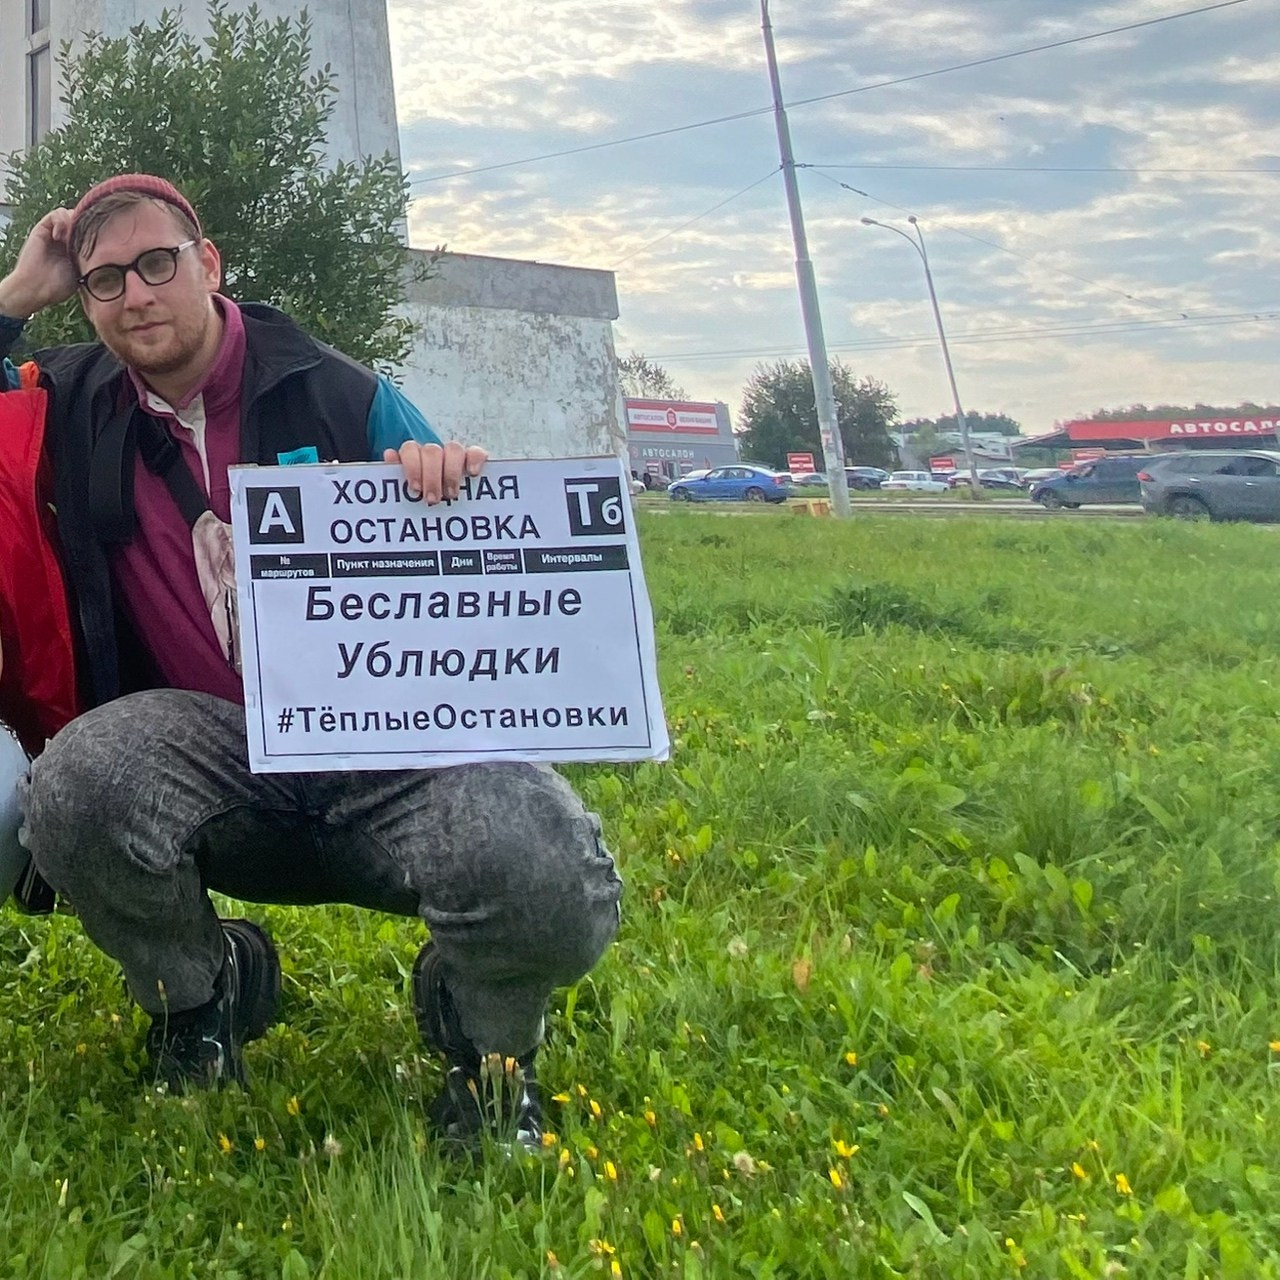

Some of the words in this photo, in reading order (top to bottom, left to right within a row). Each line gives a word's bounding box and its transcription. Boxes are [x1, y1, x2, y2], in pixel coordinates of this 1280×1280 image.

[642, 448, 695, 458] АВТОСАЛОН
[332, 475, 520, 507] ХОЛОНАЯ
[259, 491, 296, 535] А
[330, 514, 541, 544] ОСТАНОВКА
[280, 556, 291, 566] №
[336, 558, 370, 571] Пункт
[372, 557, 435, 569] назначения
[450, 556, 474, 569] Дни
[486, 552, 515, 563] Время
[541, 553, 603, 565] Интервалы
[260, 568, 315, 579] маршрутов
[485, 563, 518, 573] работы
[306, 586, 583, 621] Беславные
[336, 642, 560, 682] Ублюдки
[277, 703, 629, 733] #ТёплыеОстановки
